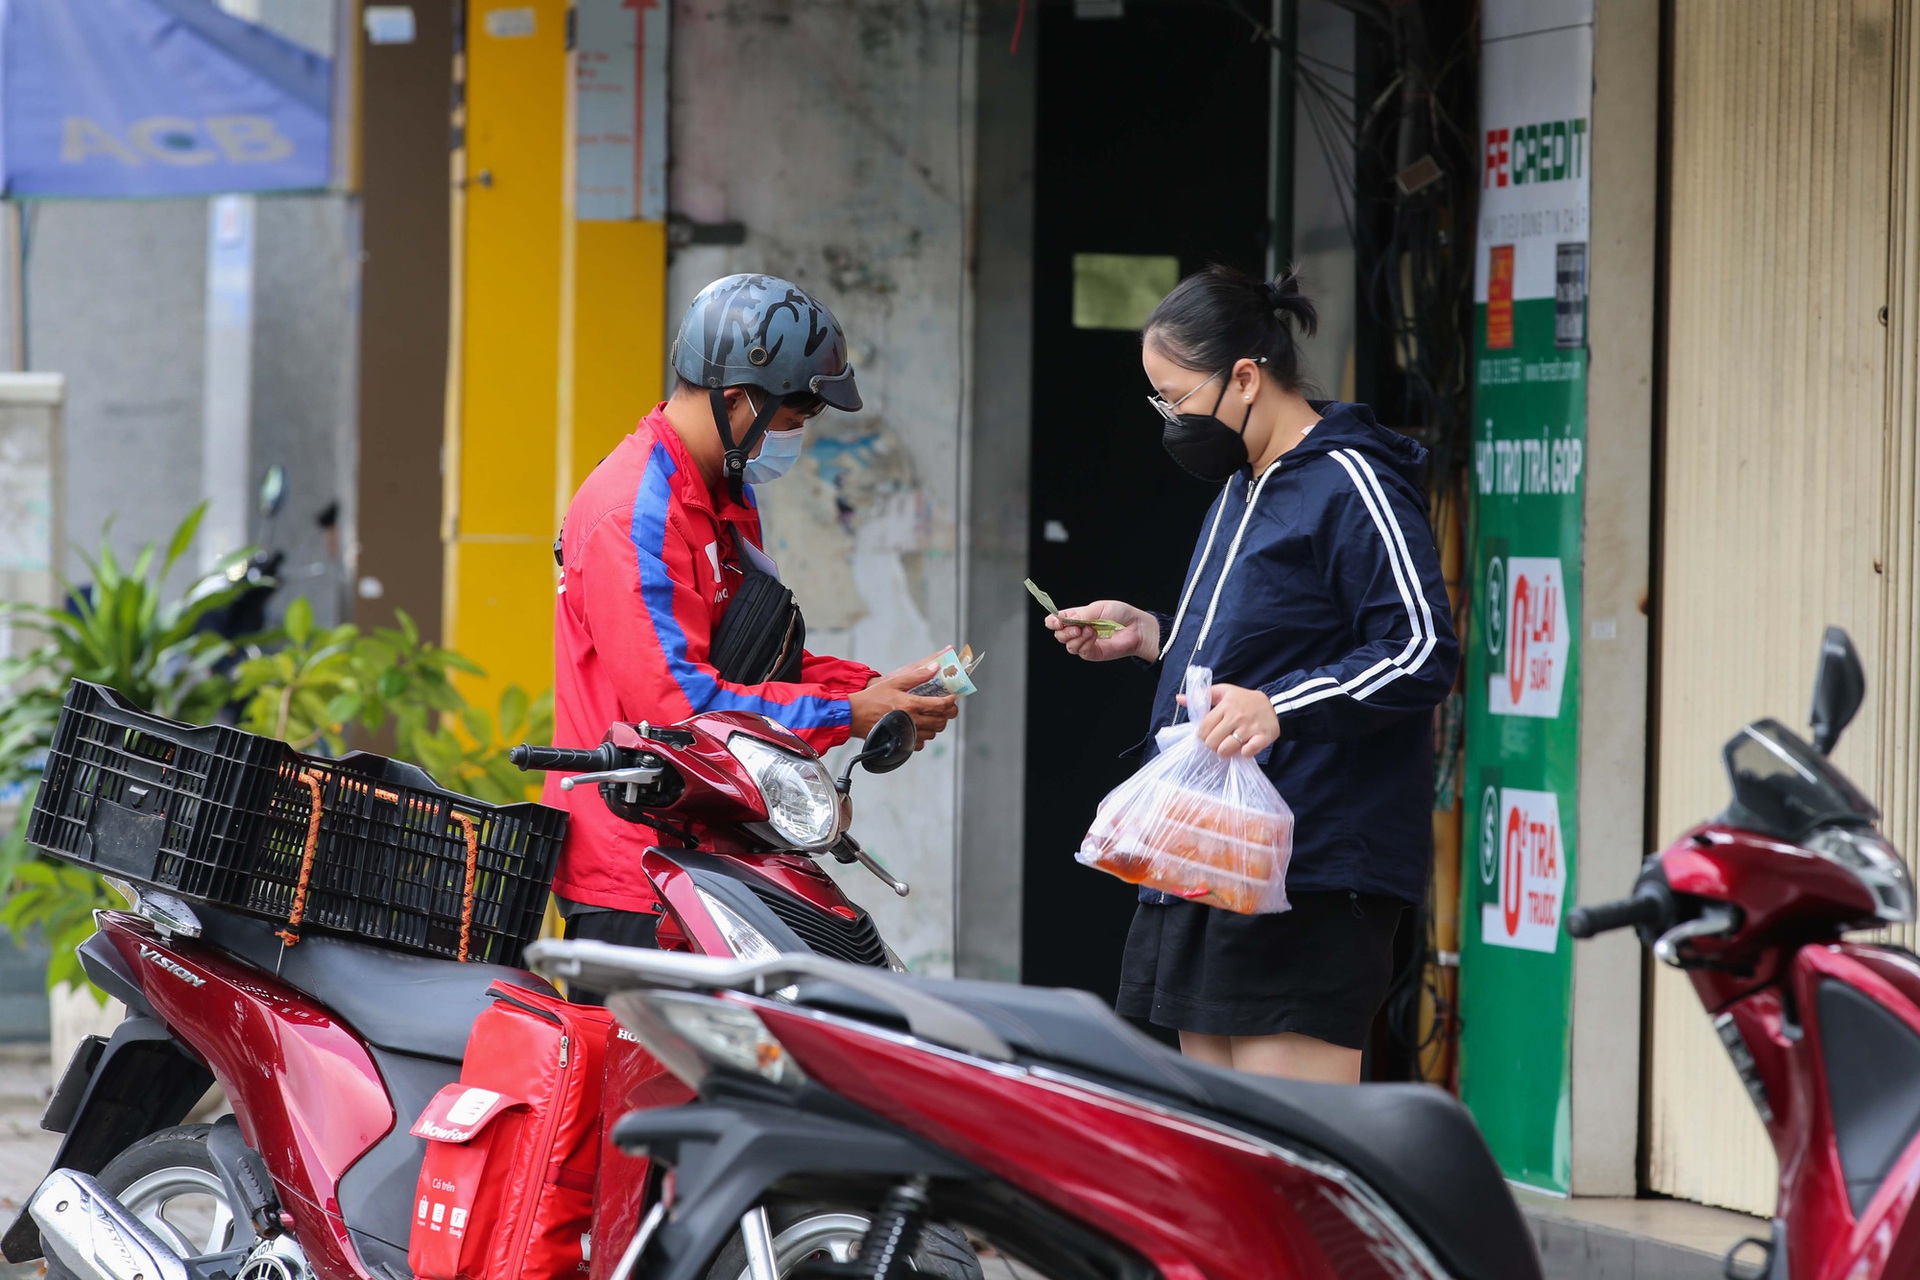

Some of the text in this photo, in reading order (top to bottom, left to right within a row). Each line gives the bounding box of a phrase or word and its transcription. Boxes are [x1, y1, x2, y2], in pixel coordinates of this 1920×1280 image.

[60, 115, 294, 167] ACB
[1485, 118, 1587, 188] FE CREDIT
[1551, 423, 1583, 495] GÓP
[140, 943, 207, 988] VISION
[432, 1178, 442, 1190] Có
